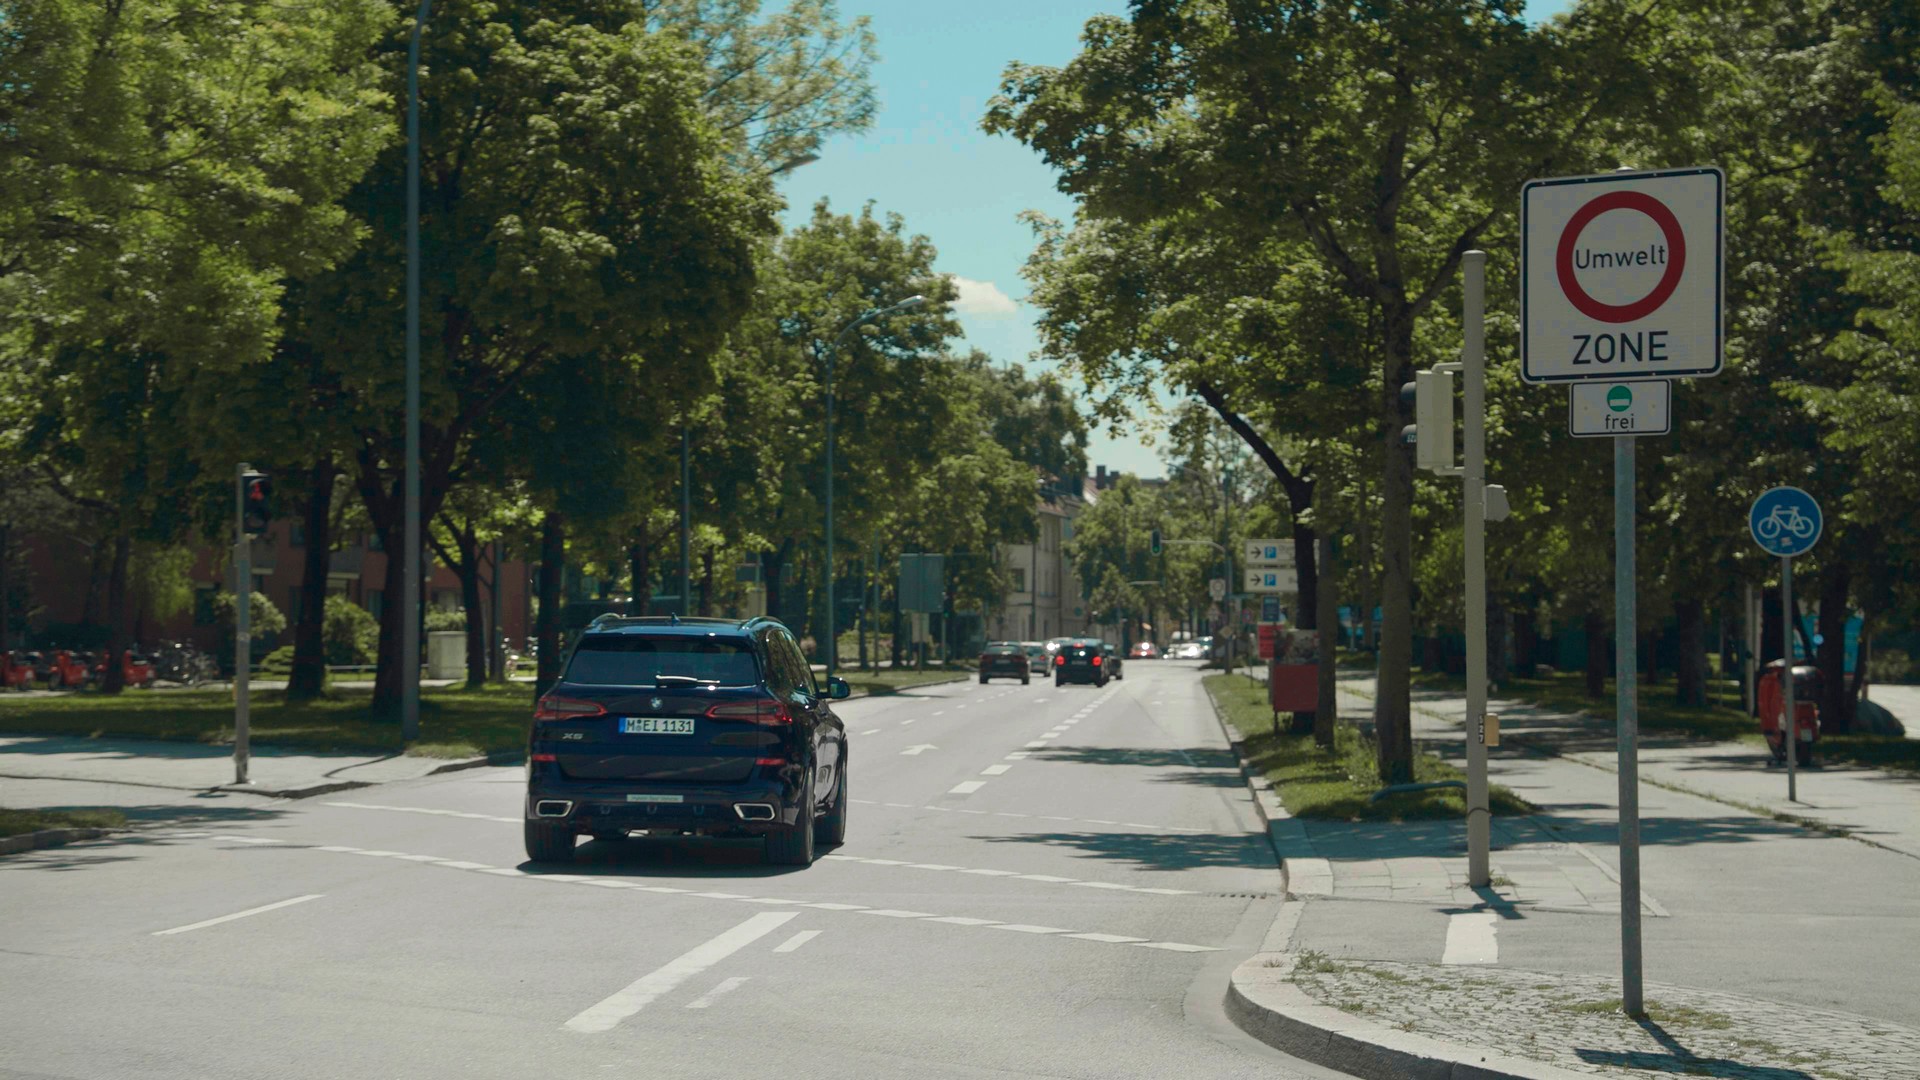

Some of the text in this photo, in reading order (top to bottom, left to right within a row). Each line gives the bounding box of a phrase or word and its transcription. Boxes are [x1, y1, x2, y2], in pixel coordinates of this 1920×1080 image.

[1575, 244, 1666, 270] Umwelt
[1572, 330, 1669, 365] ZONE
[1605, 413, 1635, 430] frei
[662, 720, 693, 733] 1131
